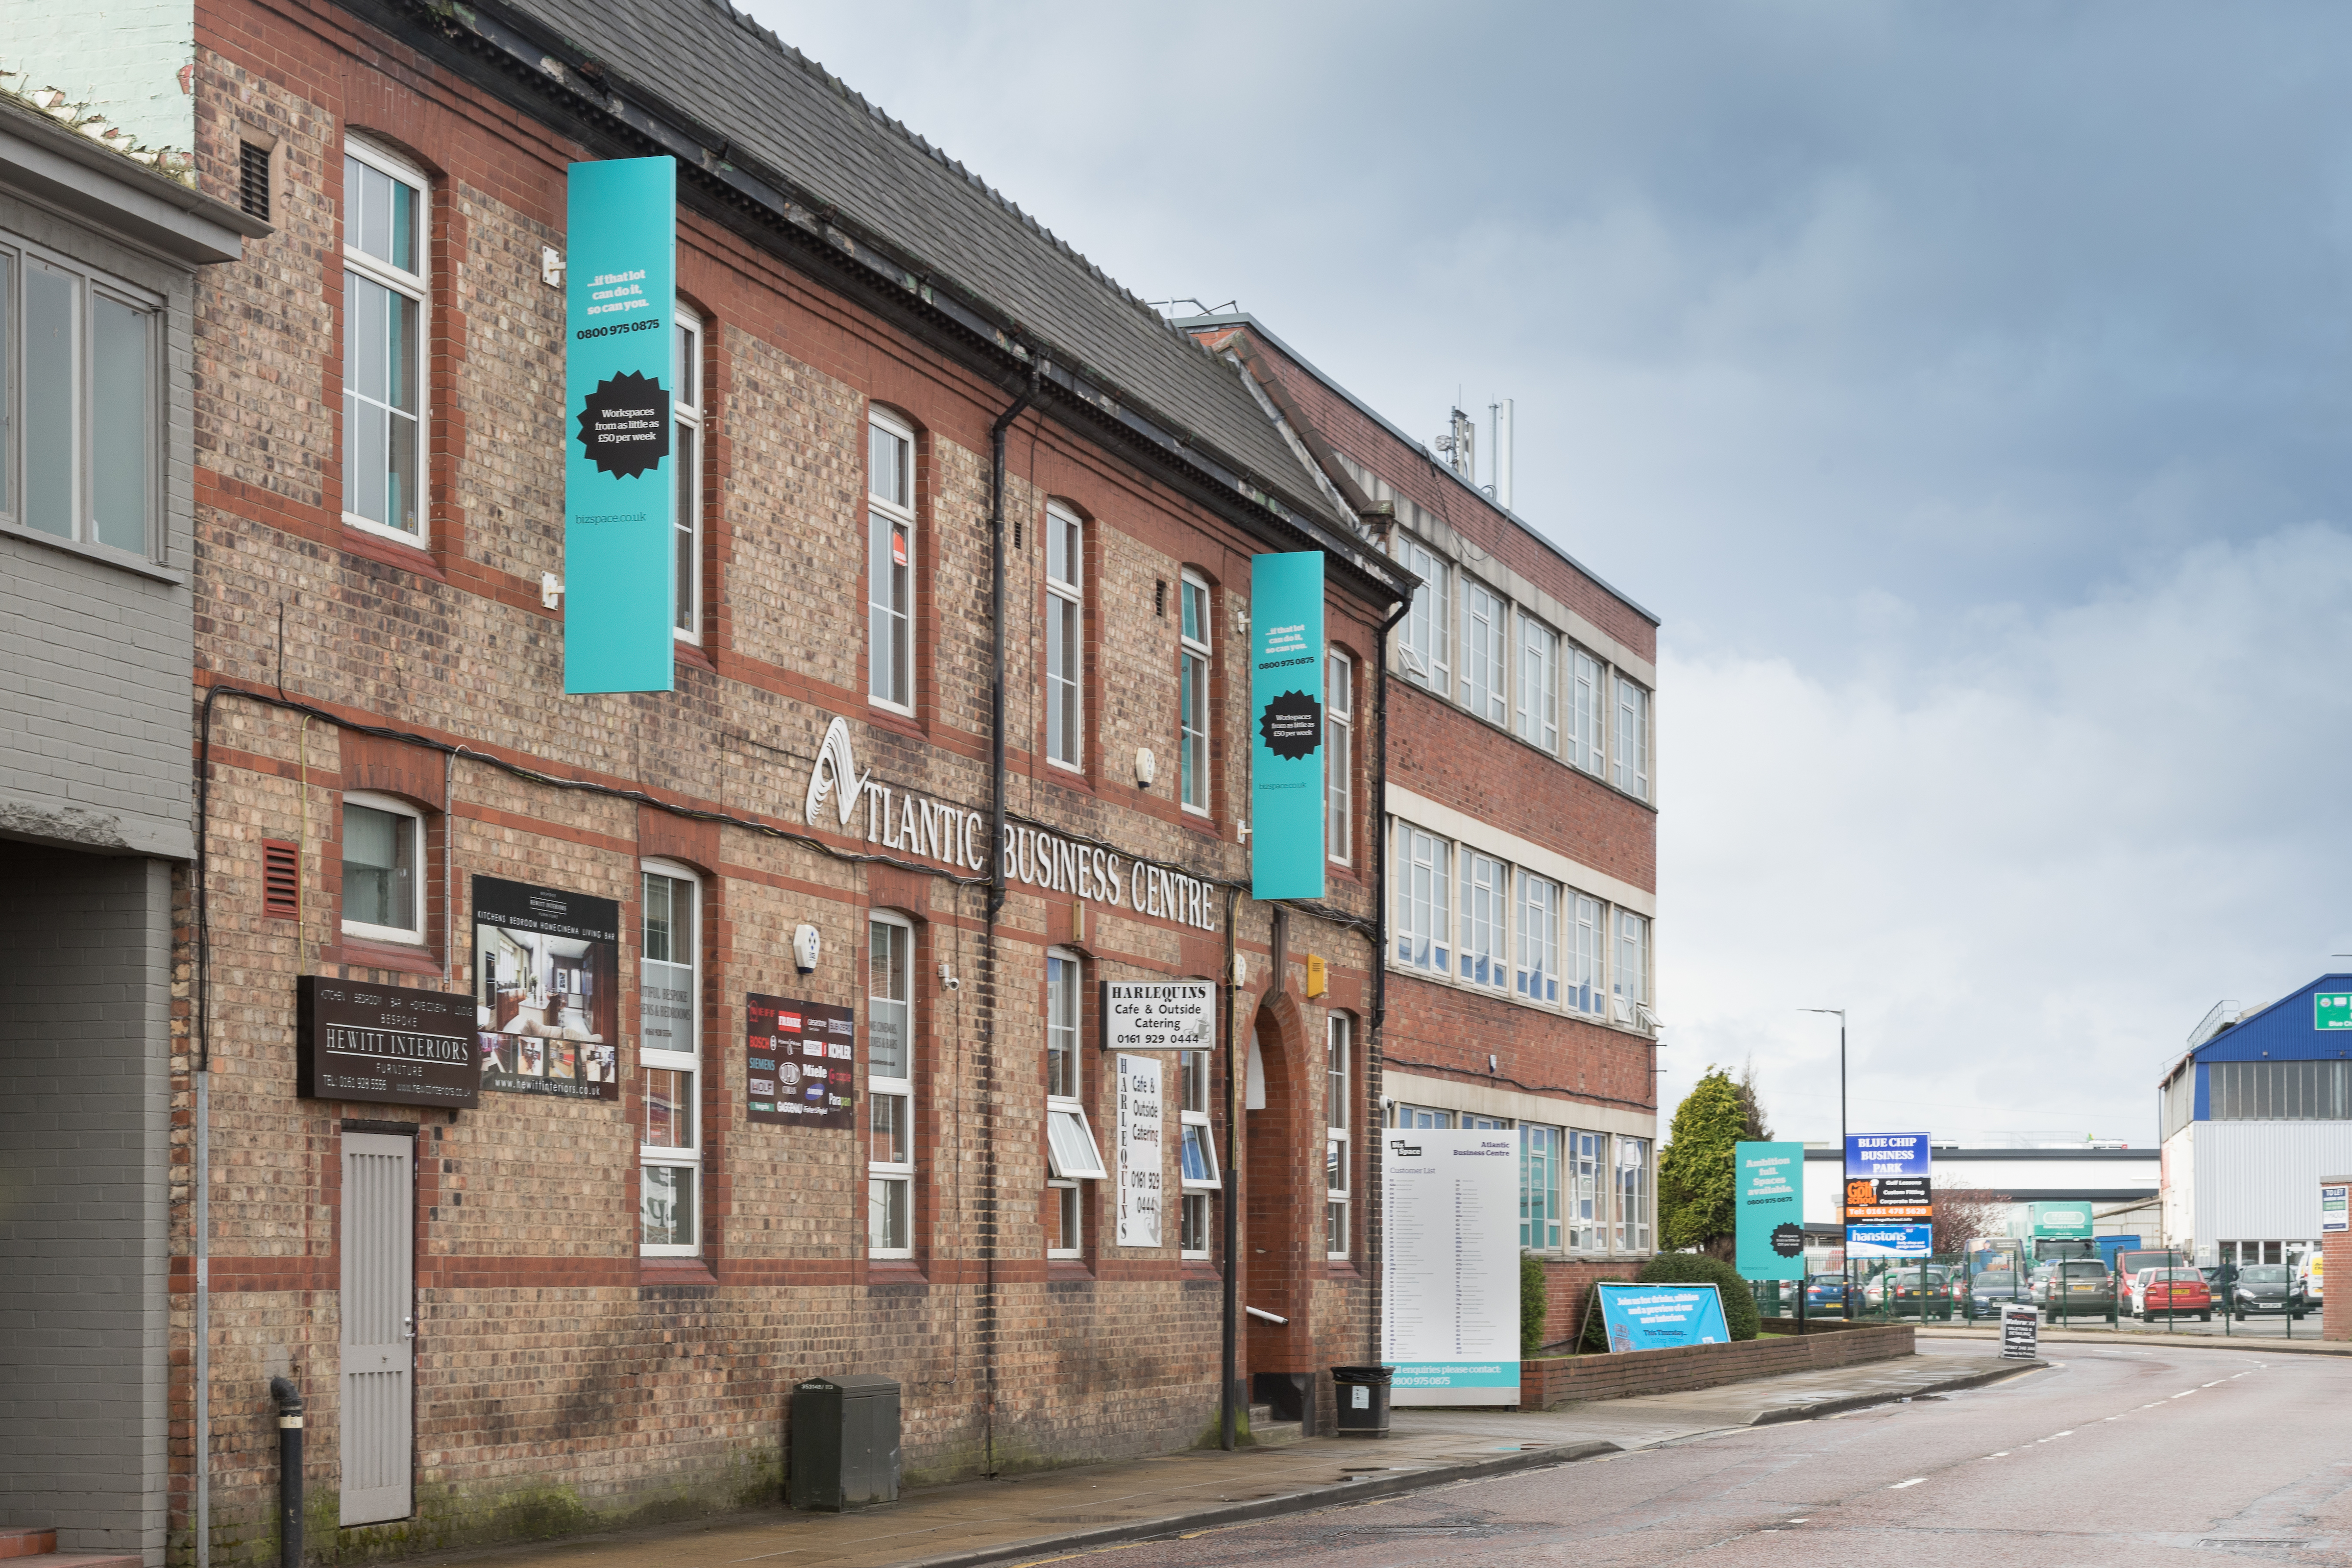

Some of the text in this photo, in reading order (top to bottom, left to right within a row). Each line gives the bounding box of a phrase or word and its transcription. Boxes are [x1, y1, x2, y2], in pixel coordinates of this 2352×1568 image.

[604, 270, 646, 284] that lot
[592, 284, 642, 300] can do it,
[587, 299, 649, 315] so can you.
[577, 319, 660, 340] 0800 975 0875
[602, 409, 655, 418] Workspaces
[628, 420, 648, 428] little
[598, 432, 656, 443] £50 per week
[575, 512, 646, 525] bizspace.co.uk
[1004, 823, 1121, 906] BUSINESS
[1131, 860, 1215, 932] CENTRE
[477, 911, 506, 923] KITCHENS
[509, 916, 538, 928] BEDROOM
[557, 924, 579, 934] CINEMA
[582, 929, 601, 938] LIVING
[604, 932, 615, 940] BAR
[354, 993, 382, 1005] BEDROOM
[662, 988, 688, 1003] BESPOKE
[1112, 986, 1206, 1003] HARLEQUINS
[750, 1006, 775, 1017] NEFF
[1115, 1004, 1201, 1014] Cafe & Outside
[381, 1013, 417, 1027] BESPOKE
[1135, 1018, 1181, 1031] Catering
[326, 1029, 468, 1061] HEWITT INTERIORS
[749, 1035, 770, 1049] BOSCH
[1118, 1034, 1199, 1043] 0161 929 0444
[828, 1043, 852, 1060] KOHLER
[376, 1063, 422, 1077] FURNITURE
[749, 1057, 775, 1071] SIEMENS
[802, 1064, 827, 1078] Miele
[323, 1075, 369, 1089] TEL: 0161 928
[494, 1078, 600, 1095] www.hewittinteriors.co.uk
[1133, 1075, 1155, 1093] Cafe &
[829, 1092, 851, 1109] Parapan
[1133, 1100, 1158, 1118] Outside
[1133, 1124, 1159, 1147] Catering
[1858, 1137, 1917, 1148] BLUE CHIP
[1120, 1058, 1128, 1239] HARLEQUINS
[1398, 1148, 1421, 1156] Space
[1861, 1150, 1914, 1160] BUSINESS
[1746, 1157, 1790, 1168] Ambition
[1872, 1163, 1903, 1173] PARK
[1759, 1167, 1779, 1176] full.
[1131, 1171, 1159, 1189] 0161 929
[1753, 1177, 1787, 1187] Spaces
[1747, 1185, 1794, 1196] available.
[1847, 1181, 1873, 1198] Golf
[1137, 1197, 1155, 1214] 0444
[1847, 1195, 1877, 1204] school
[1852, 1230, 1907, 1241] hanstons
[1640, 1296, 1651, 1304] for
[1628, 1306, 1642, 1315] and
[1646, 1304, 1674, 1315] preview
[1674, 1303, 1681, 1312] of
[1402, 1366, 1441, 1374] enquiries
[1442, 1366, 1469, 1374] please
[1391, 1377, 1413, 1385] 0800
